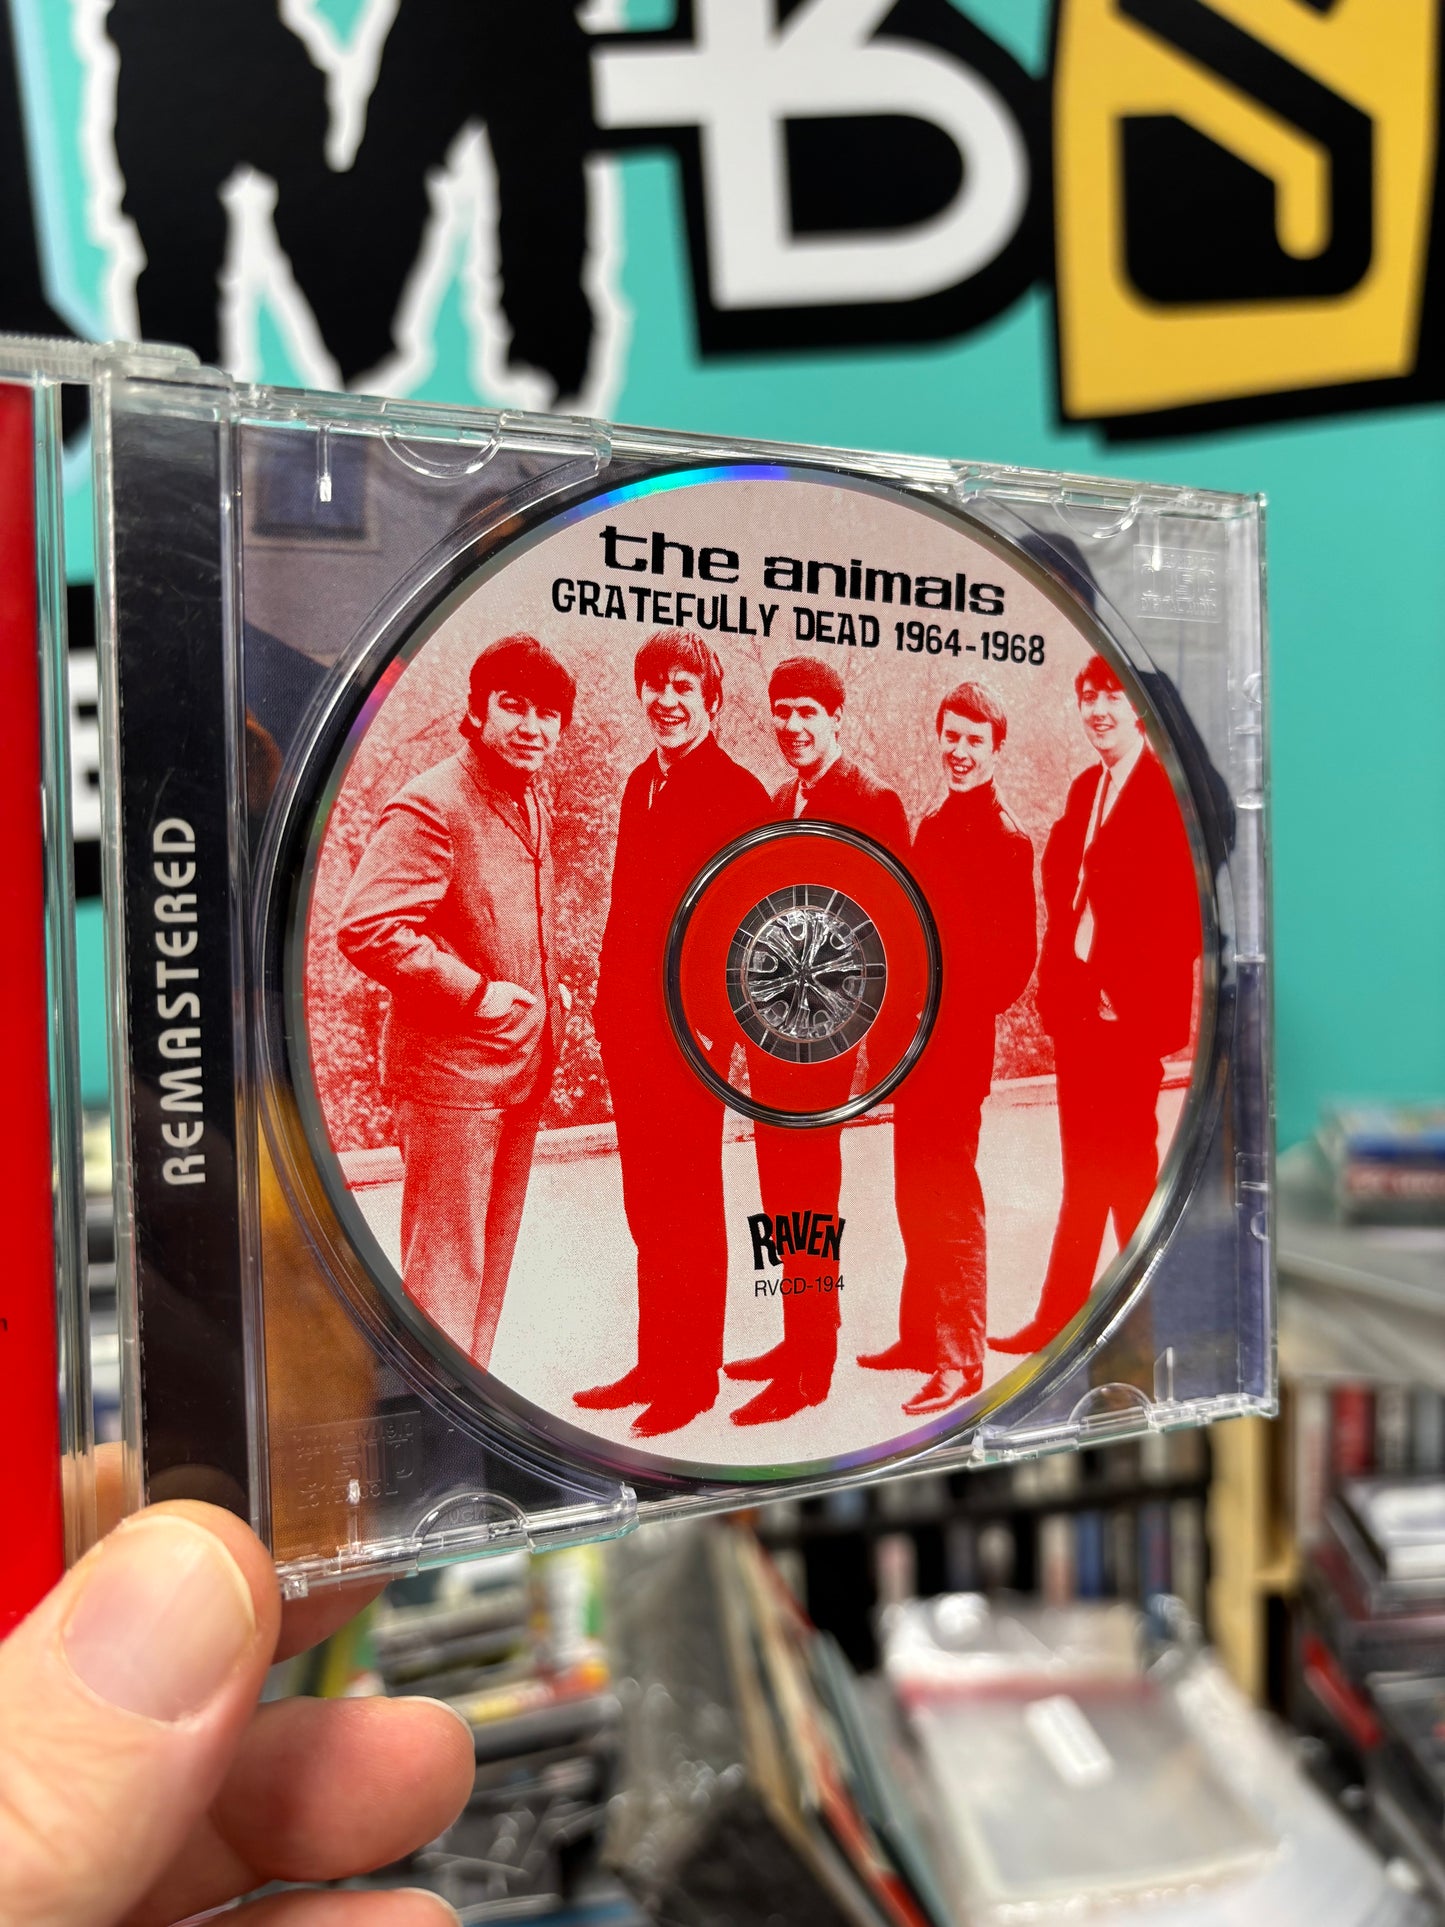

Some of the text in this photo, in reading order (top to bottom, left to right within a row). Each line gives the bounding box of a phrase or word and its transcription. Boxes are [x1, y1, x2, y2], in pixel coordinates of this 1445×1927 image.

[599, 525, 1005, 617] the animals
[551, 577, 1046, 666] GRATEFULLY DEAD 1964-1968
[152, 817, 206, 1186] REMASTERED
[747, 1209, 846, 1270] RAVEN
[754, 1274, 845, 1298] RVCD-194
